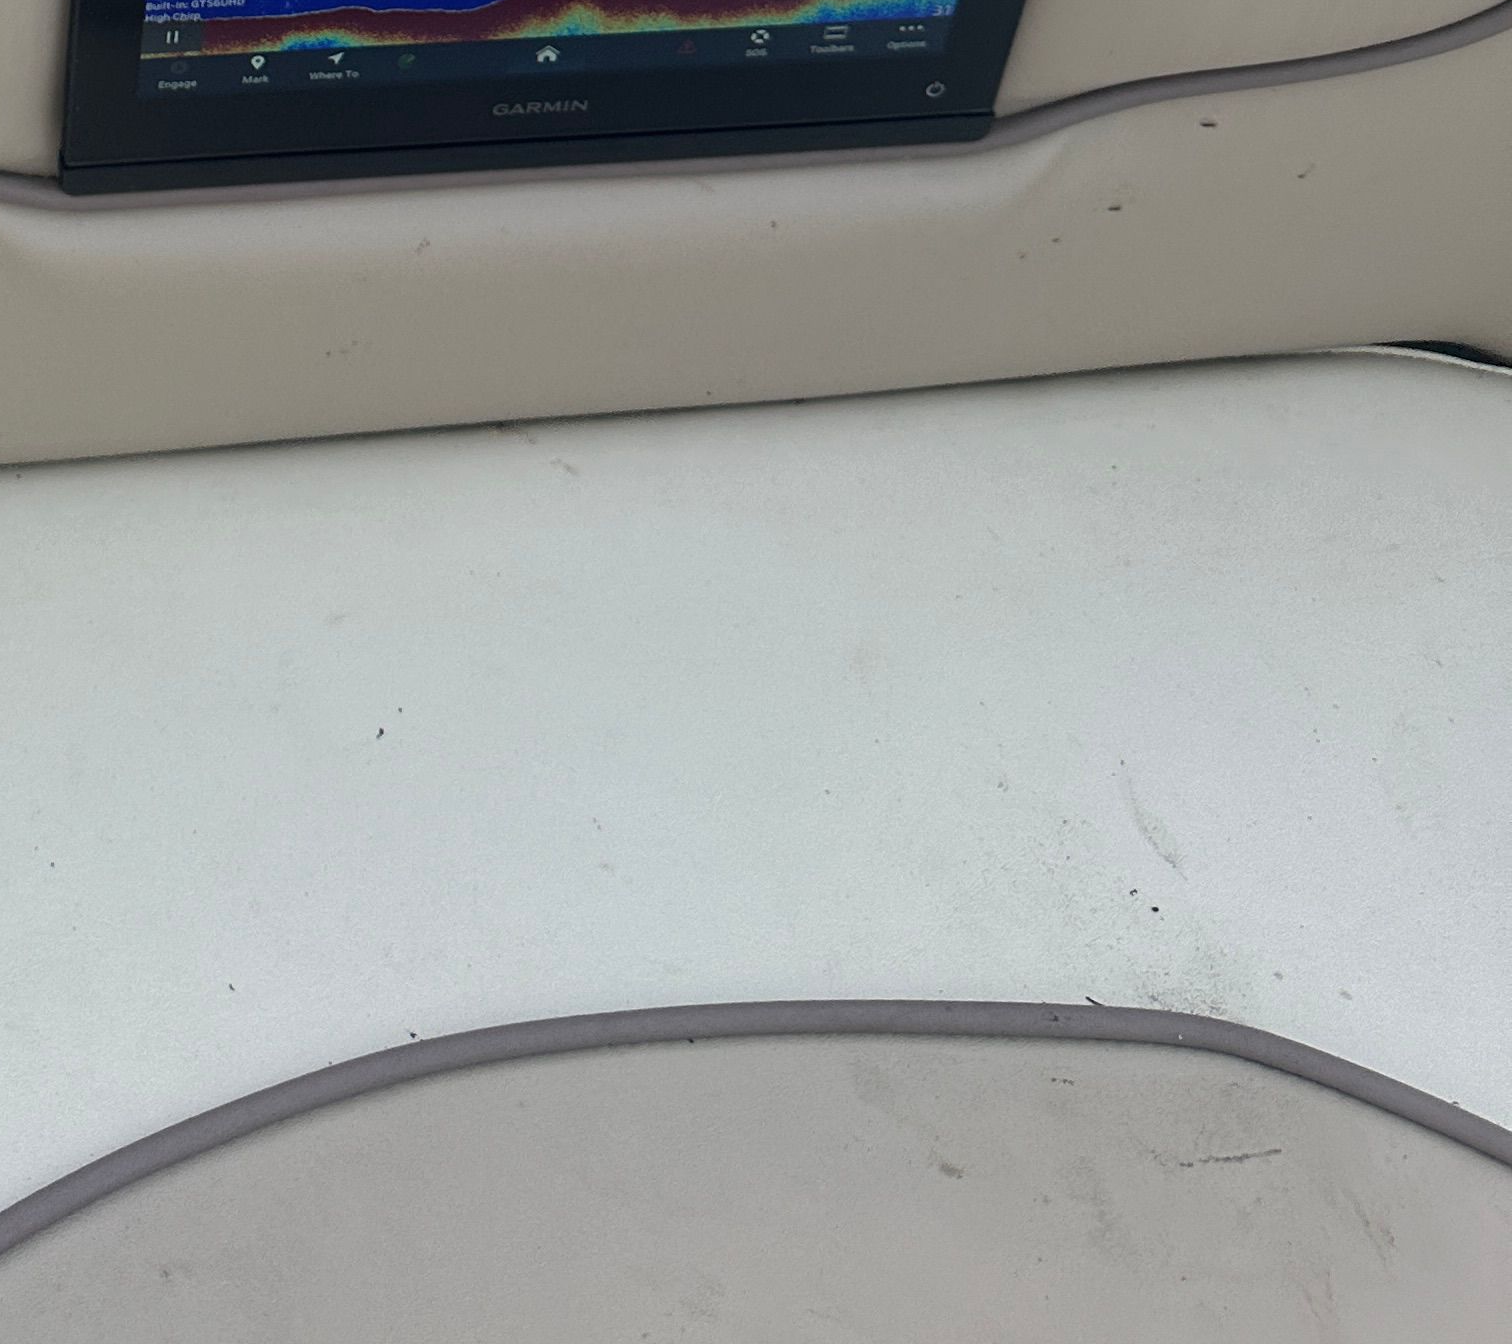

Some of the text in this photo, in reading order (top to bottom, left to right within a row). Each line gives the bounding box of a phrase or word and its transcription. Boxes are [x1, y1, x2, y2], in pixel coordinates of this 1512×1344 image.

[241, 74, 270, 85] Mark
[309, 69, 361, 81] Where To
[158, 79, 198, 92] Engage
[492, 99, 588, 116] GARMIN
